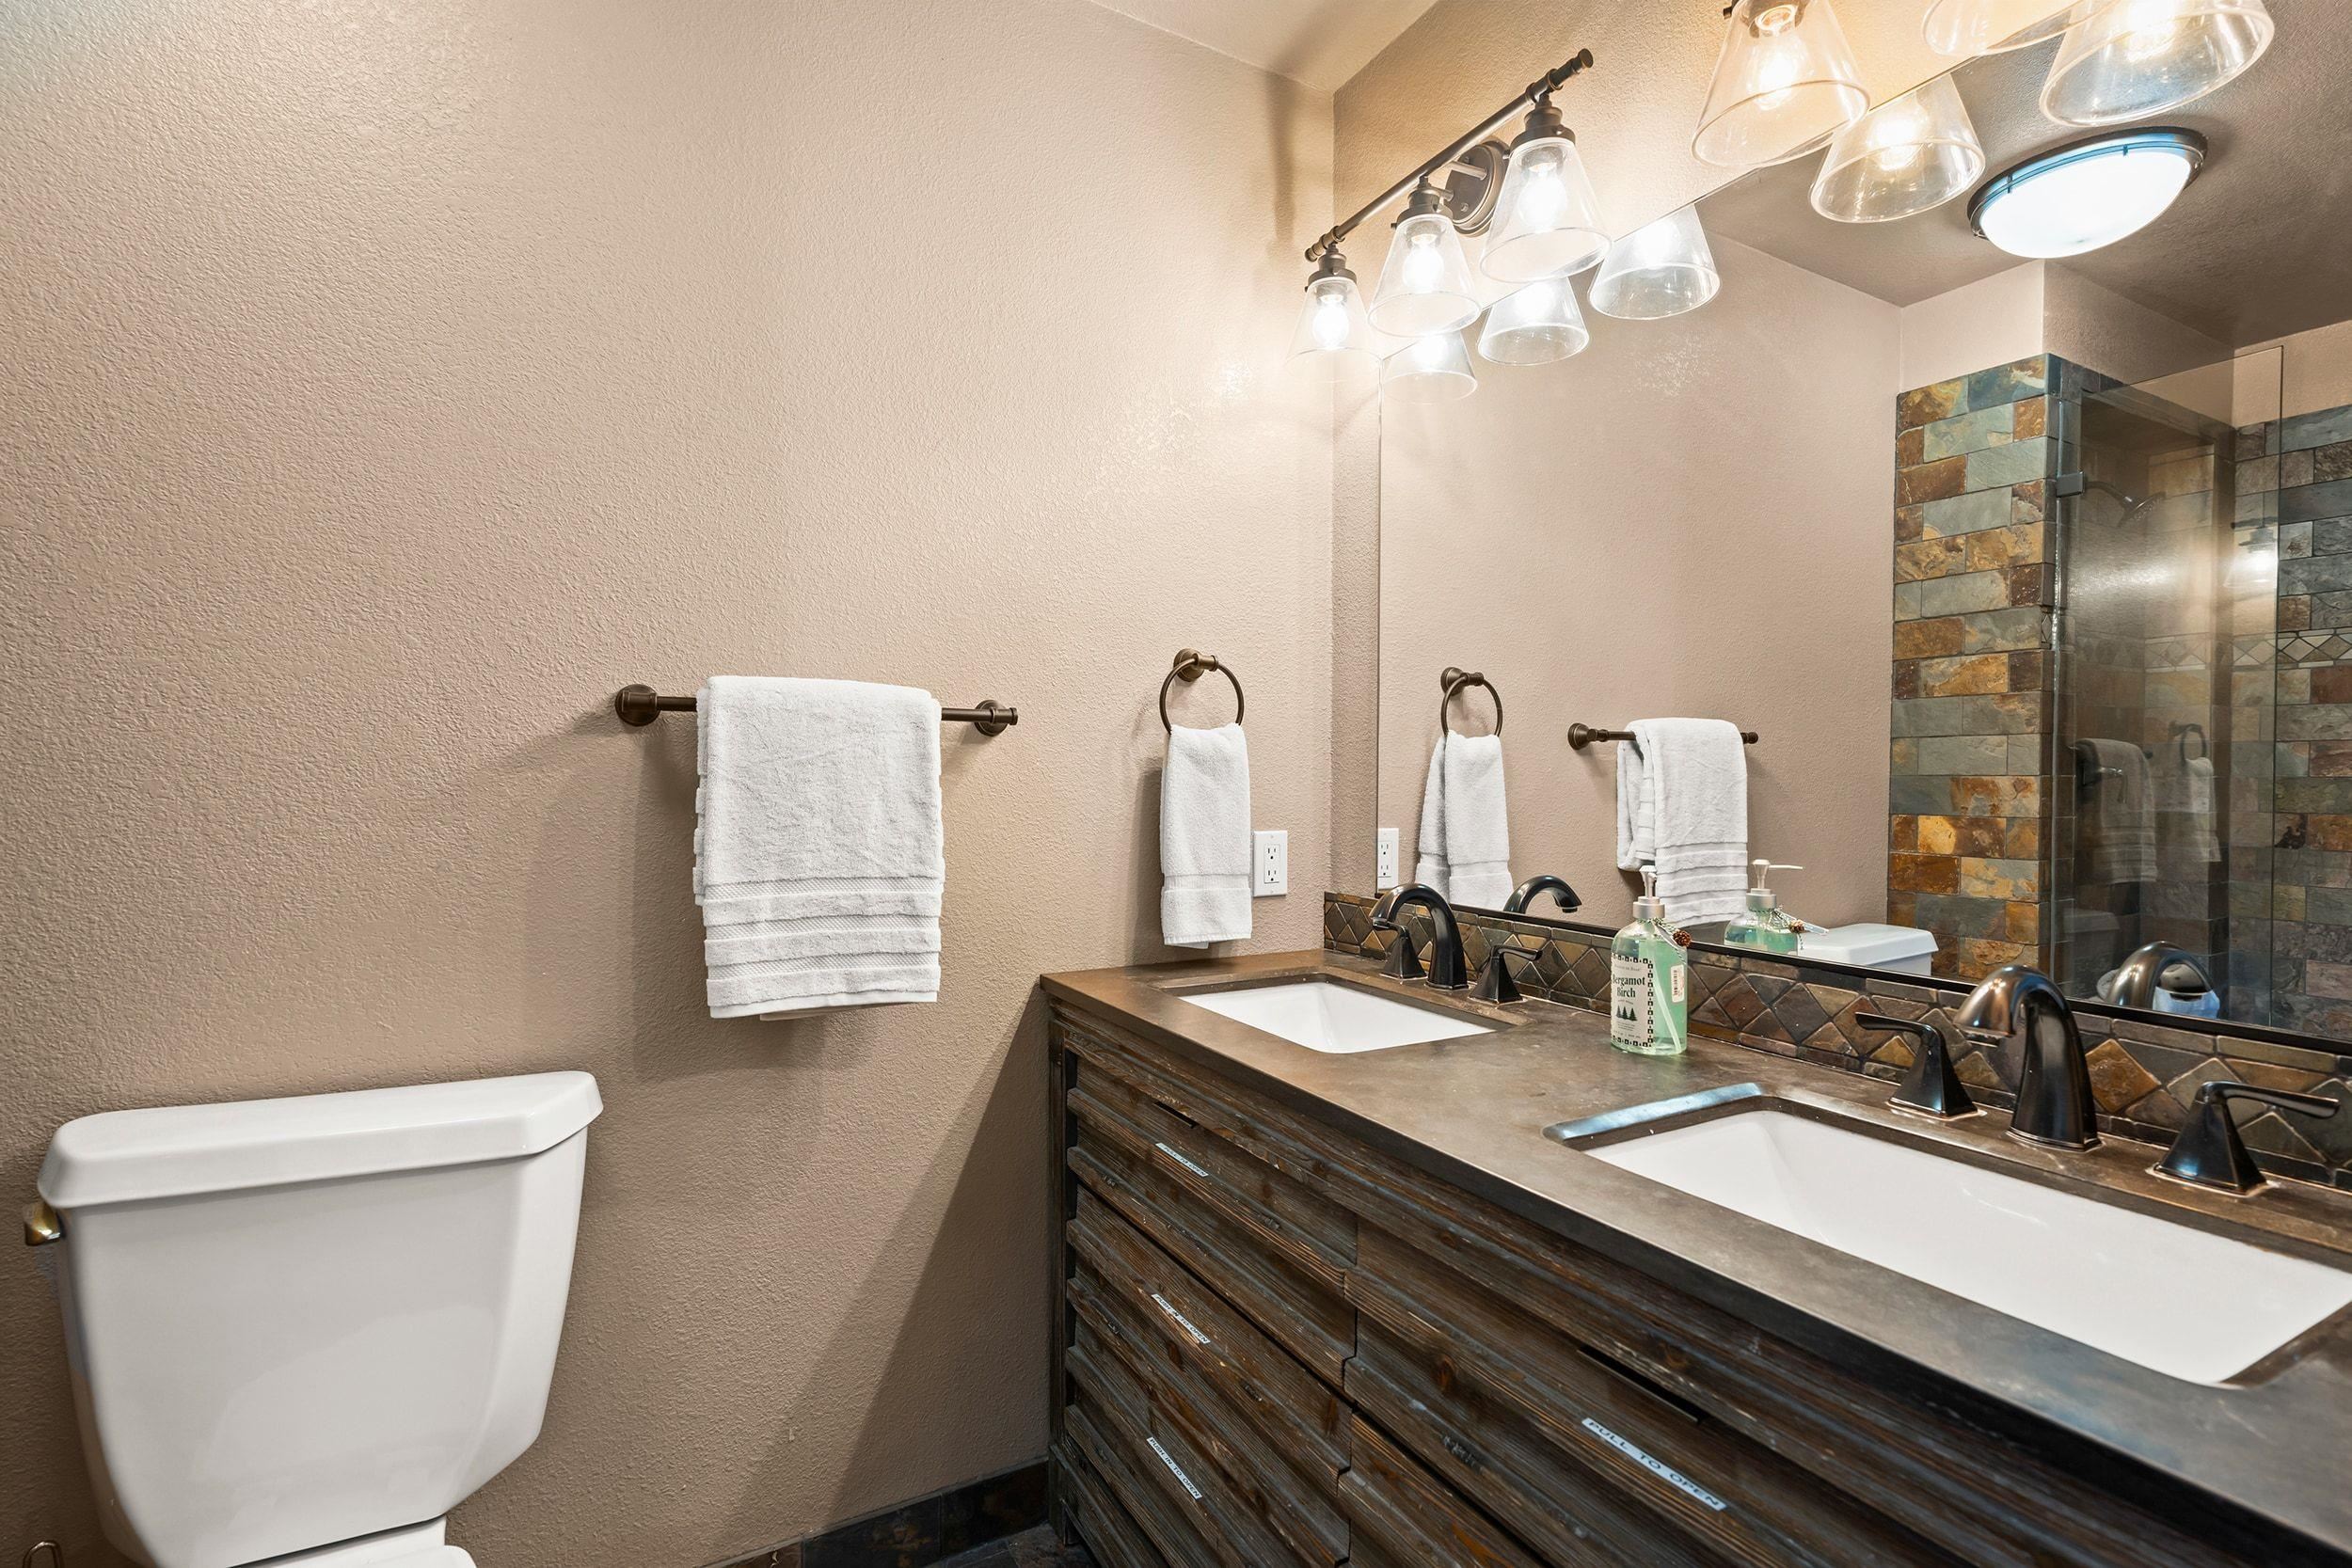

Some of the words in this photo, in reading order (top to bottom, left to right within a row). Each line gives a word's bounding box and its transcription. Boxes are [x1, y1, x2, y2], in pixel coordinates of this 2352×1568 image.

[1616, 987, 1636, 998] Birch
[1155, 1296, 1170, 1309] PUSH
[1190, 1327, 1208, 1342] OPEN
[1150, 1438, 1165, 1455] PUSH
[1173, 1466, 1183, 1476] TO
[1183, 1478, 1200, 1497] OPEN
[1588, 1421, 1629, 1449] PULL
[1639, 1453, 1661, 1470] TO
[1670, 1473, 1719, 1506] OPEN
